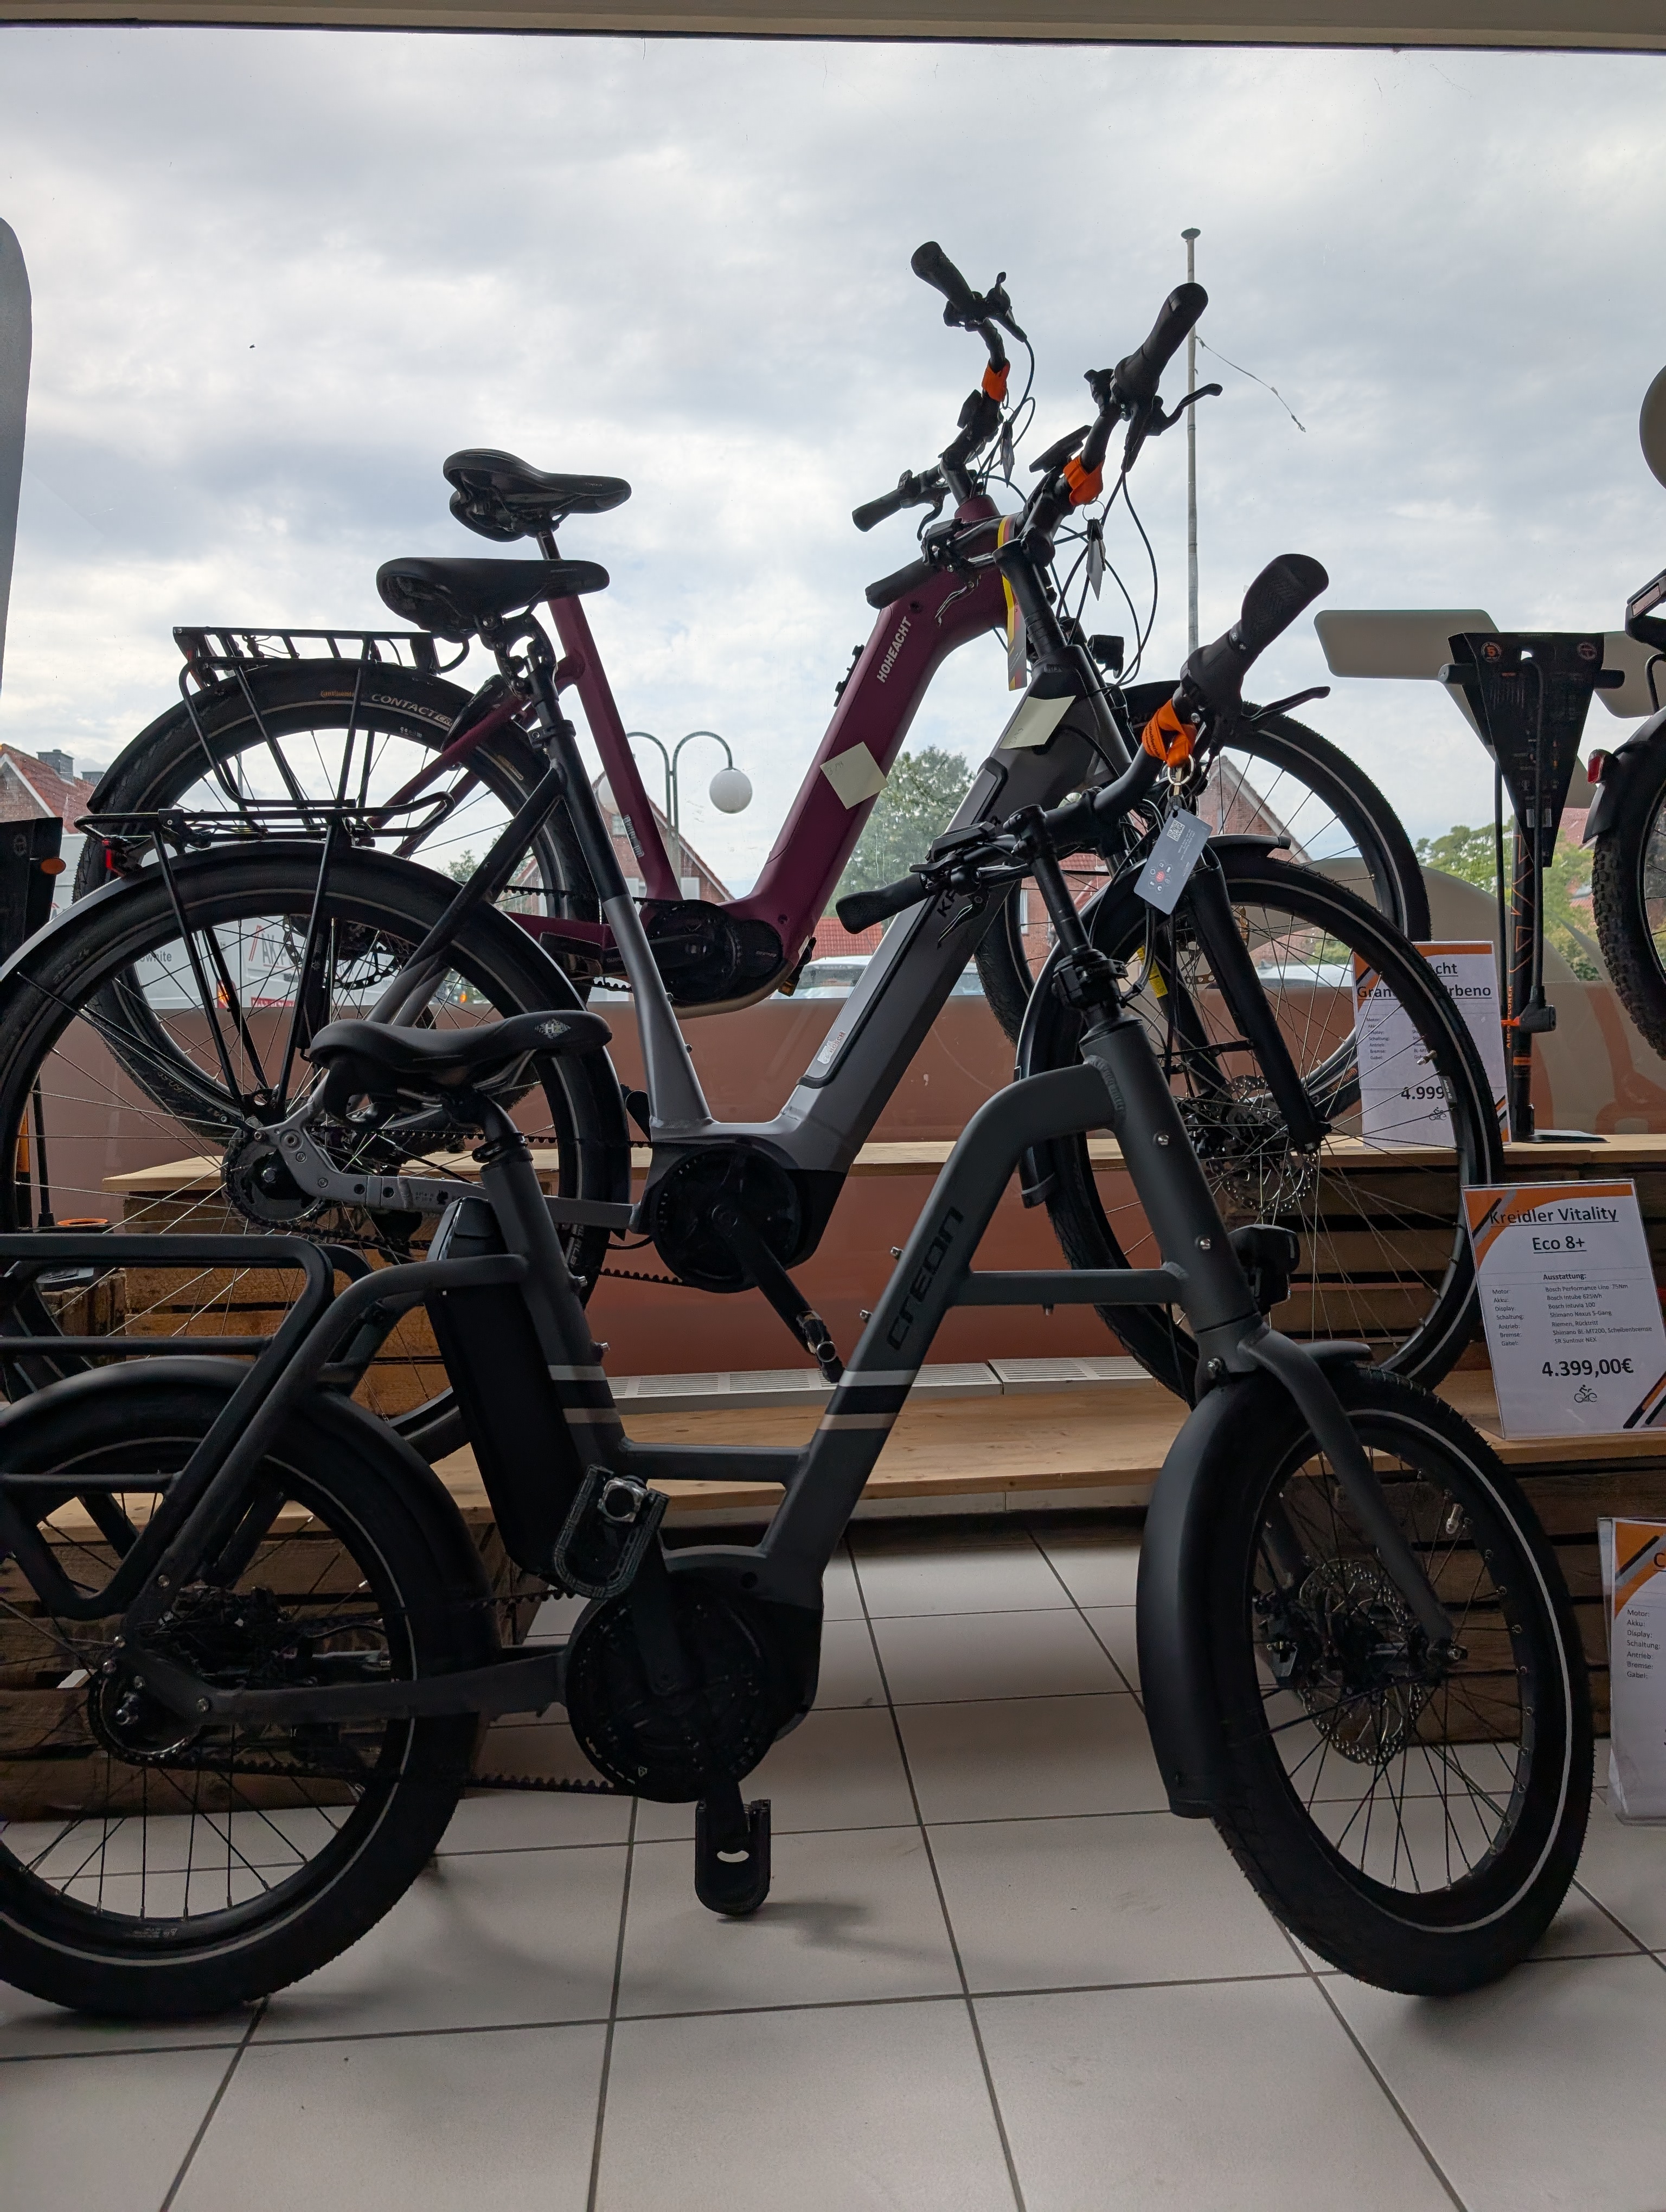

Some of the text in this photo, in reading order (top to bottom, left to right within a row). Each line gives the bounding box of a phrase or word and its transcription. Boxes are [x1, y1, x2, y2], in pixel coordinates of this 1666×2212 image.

[876, 616, 912, 683] HOHEACHT
[371, 693, 453, 726] CONTACT CR
[1490, 1206, 1618, 1225] Kreidler Vitality
[1533, 1235, 1585, 1251] Eco 8+
[1543, 1272, 1587, 1282] Ausstattung:
[1542, 1358, 1634, 1378] 4.399,00€
[1627, 1609, 1650, 1617] Motor:
[1627, 1630, 1652, 1638] Display:
[1626, 1639, 1661, 1649] Schaltung:
[1627, 1662, 1654, 1670] Bremse:
[1627, 1671, 1649, 1679] Gabel:
